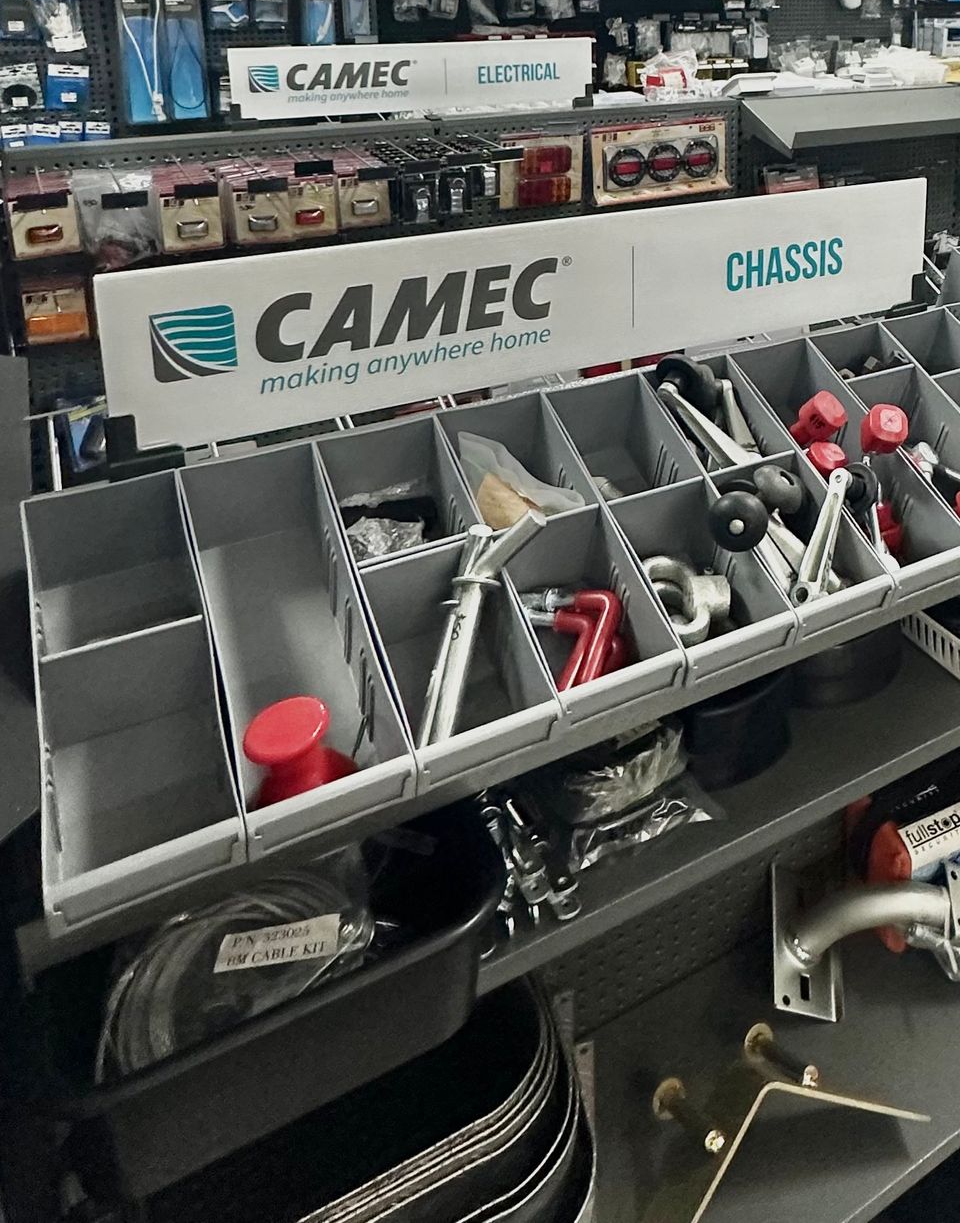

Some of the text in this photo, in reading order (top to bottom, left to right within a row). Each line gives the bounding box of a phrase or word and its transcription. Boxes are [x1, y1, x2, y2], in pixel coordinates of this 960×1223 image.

[286, 59, 560, 91] CAMEC ELECTRICAL
[288, 89, 410, 104] making anywhere home
[256, 237, 844, 363] CAMEC CHASSIS
[260, 328, 551, 395] making anywhere home
[251, 947, 298, 963] CABLE
[302, 941, 327, 955] KIT
